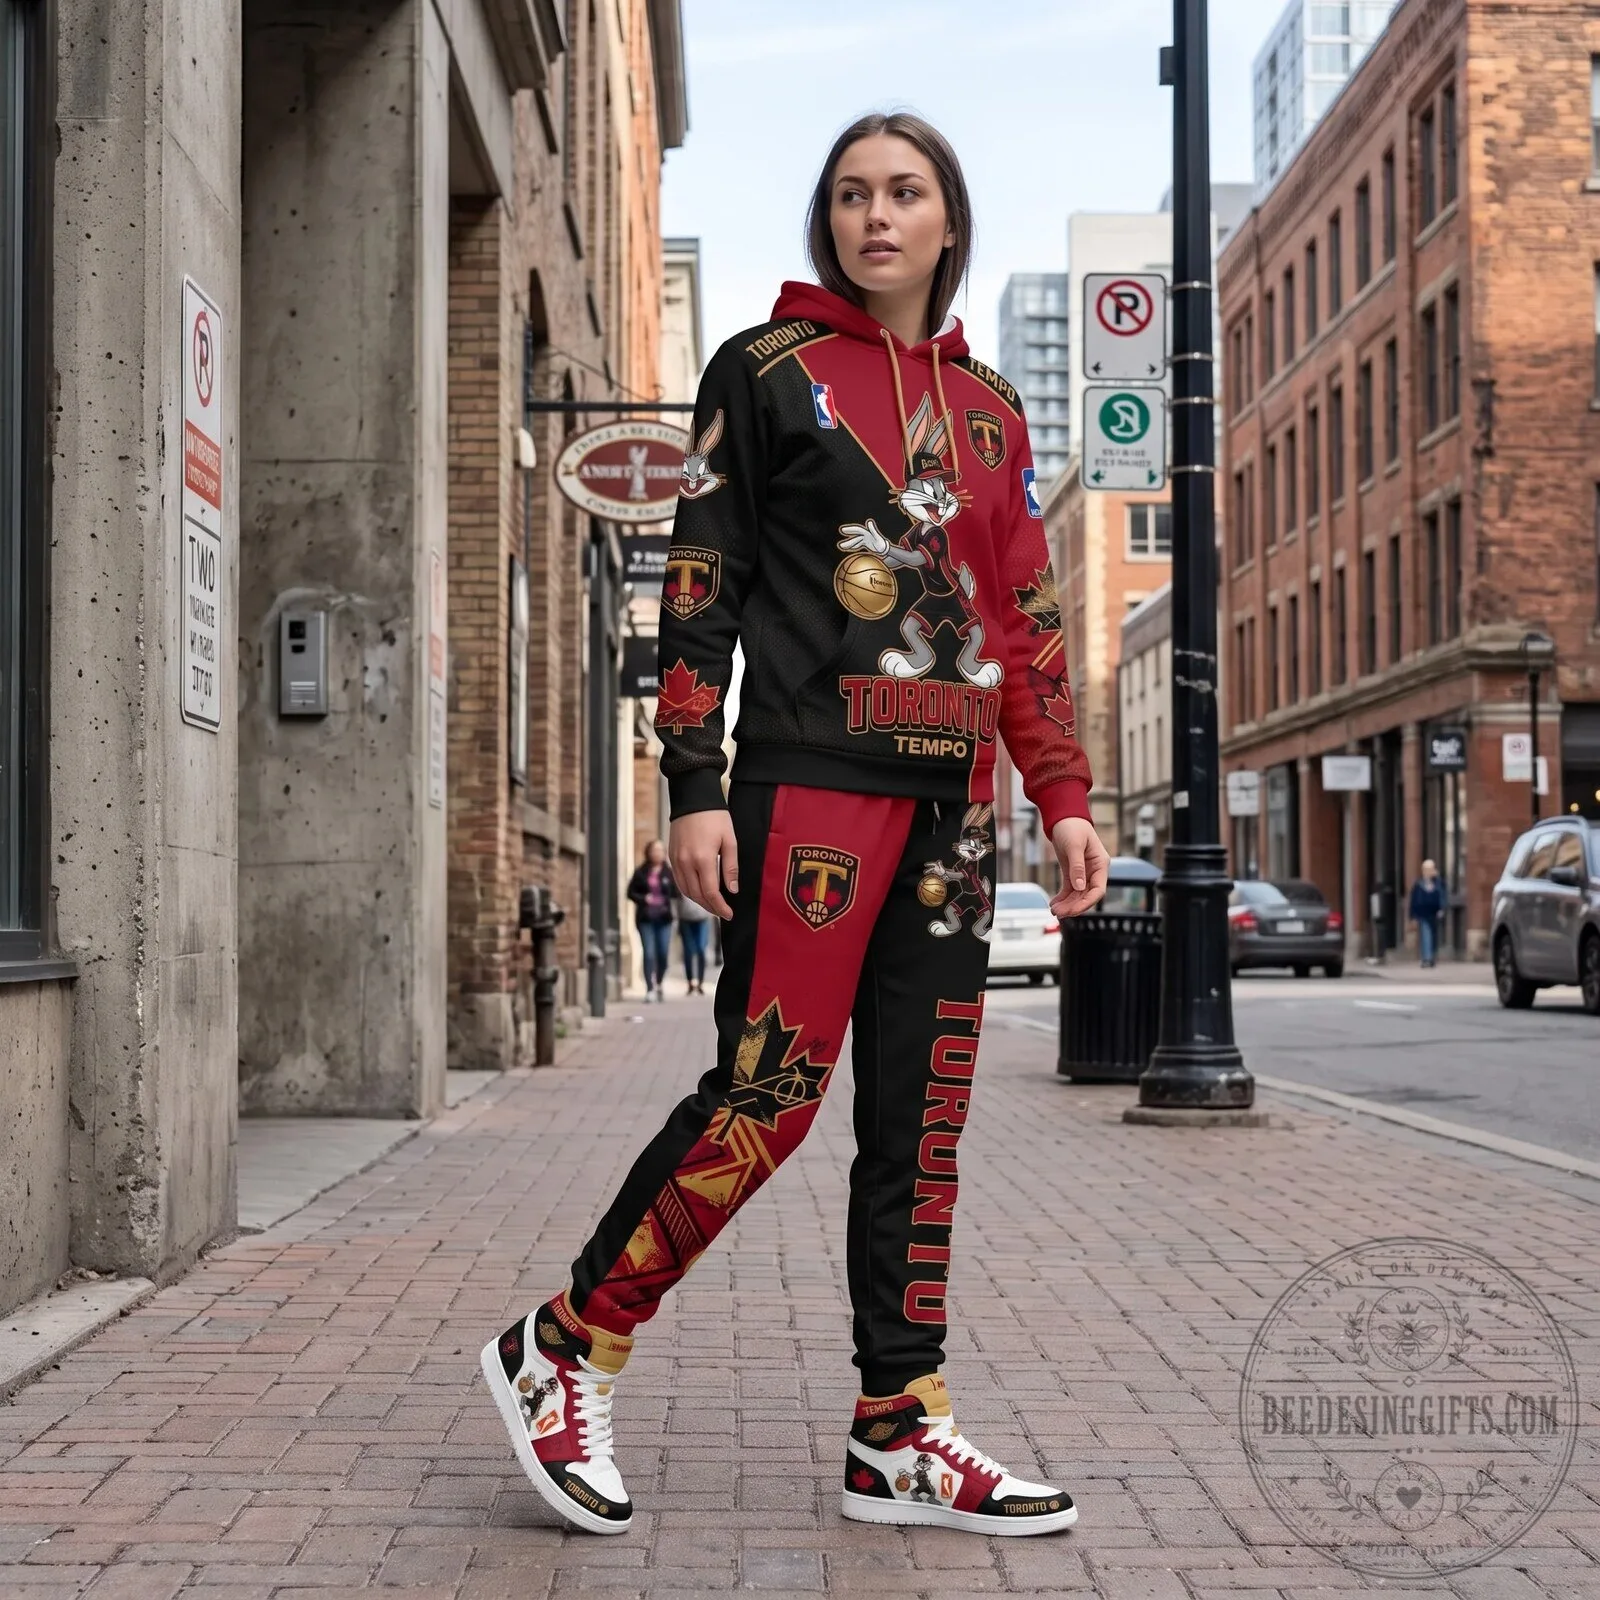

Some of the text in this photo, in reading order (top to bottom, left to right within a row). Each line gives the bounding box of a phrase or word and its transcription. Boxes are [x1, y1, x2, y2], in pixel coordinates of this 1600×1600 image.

[745, 320, 817, 360] TORONTO
[969, 356, 1016, 402] TEMPO
[189, 535, 215, 592] TWO
[839, 675, 1002, 745] TORONTO
[894, 735, 967, 758] TEMPO
[796, 849, 854, 866] TORONTO
[862, 1401, 893, 1416] TEMPO
[1003, 1501, 1047, 1514] TORONTO
